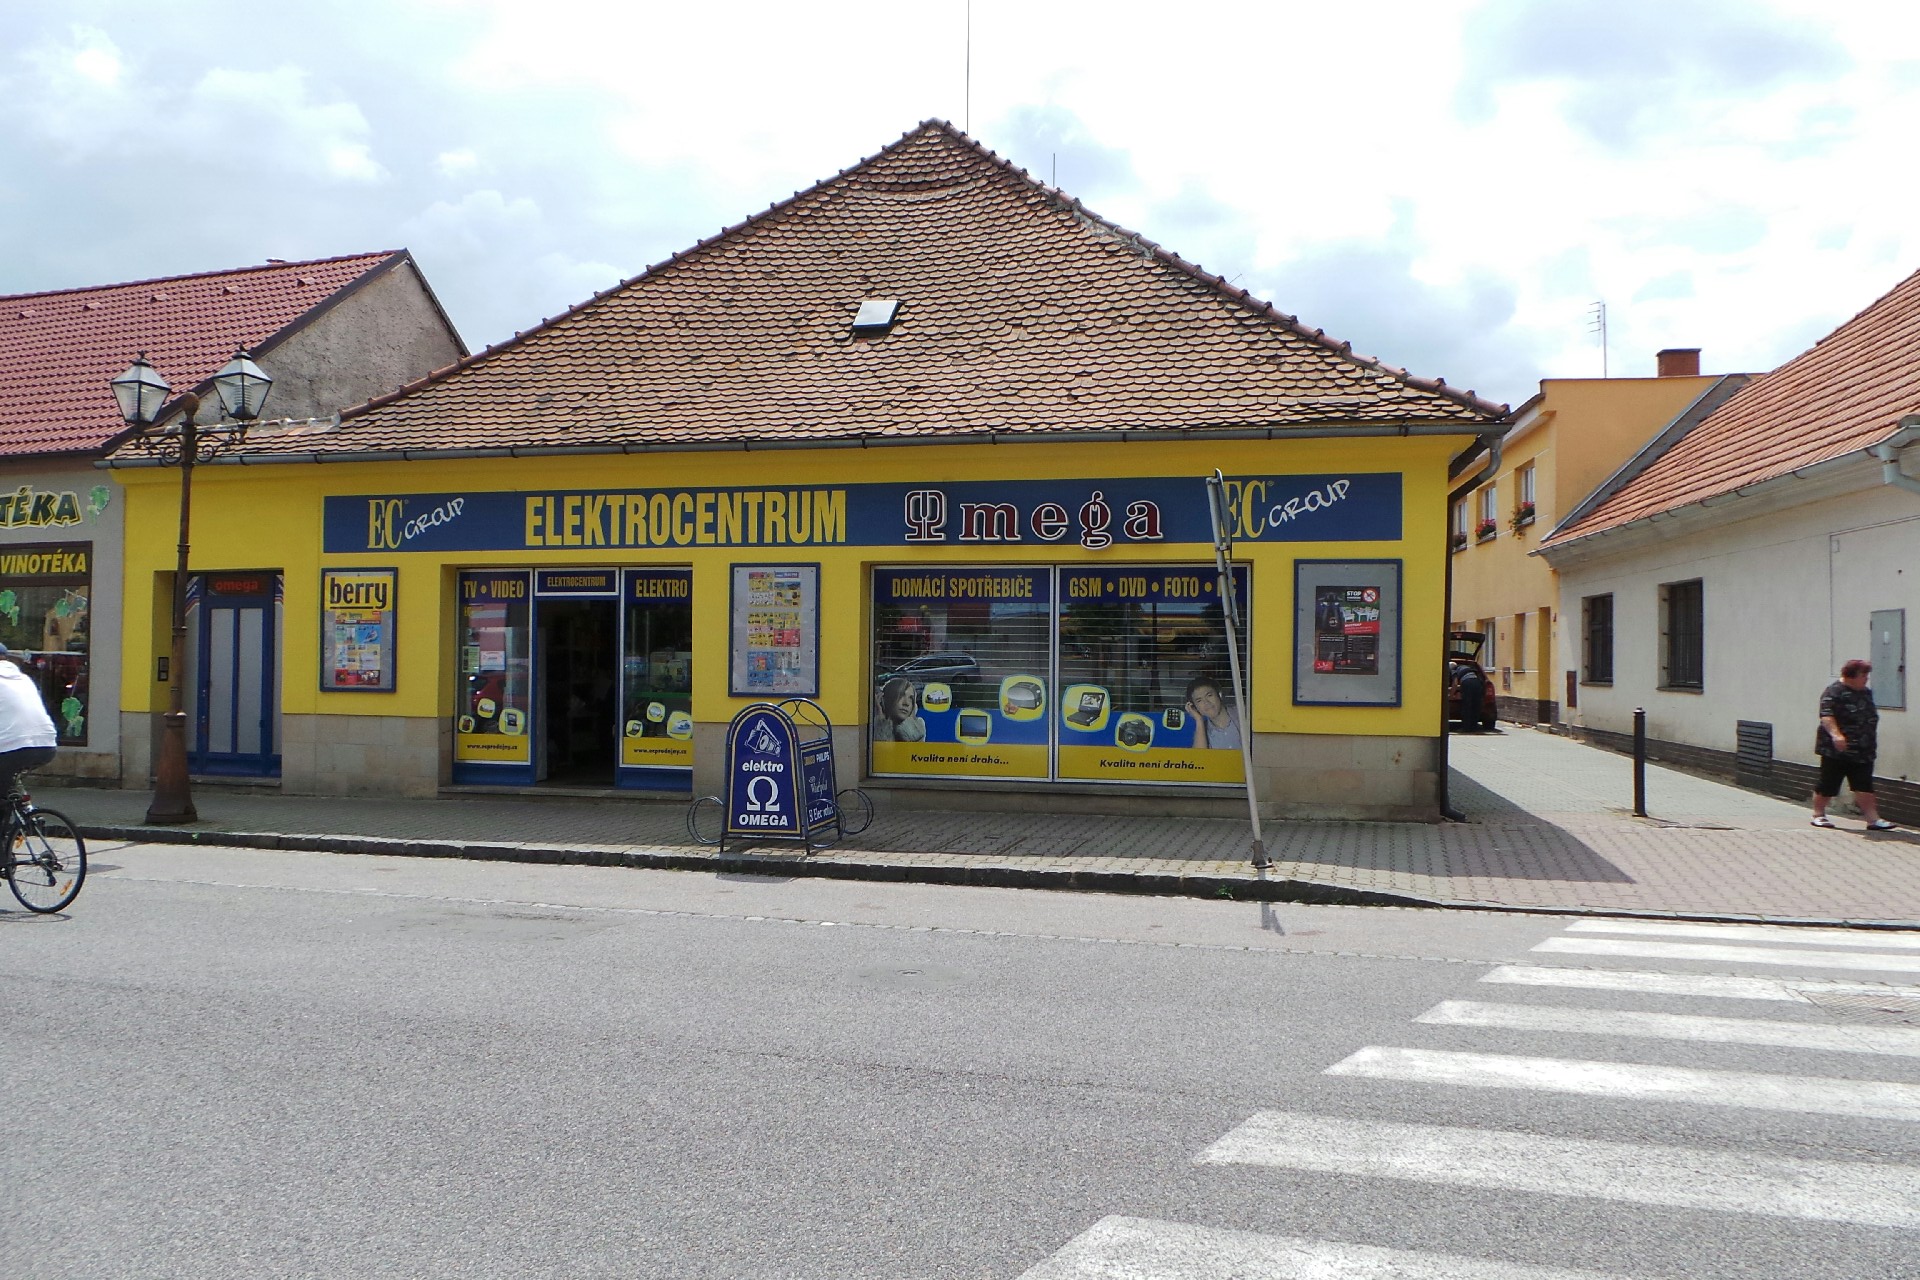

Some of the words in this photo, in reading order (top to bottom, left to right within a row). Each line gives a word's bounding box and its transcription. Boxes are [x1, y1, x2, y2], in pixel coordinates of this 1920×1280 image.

[1269, 479, 1350, 527] GROUP
[367, 500, 403, 549] EC
[404, 498, 464, 540] GROUP
[525, 490, 846, 546] ELEKTROCENTRUM
[0, 549, 87, 574] VINOTÉKA
[464, 581, 477, 598] TV
[490, 581, 524, 598] VIDEO
[547, 576, 606, 588] ELEKTROCENTRUM
[635, 579, 688, 598] ELEKTRO
[892, 575, 945, 598] DOMÁCÍ
[949, 575, 1032, 598] SPOTŘEBIČE
[1069, 576, 1101, 598] GSM
[1119, 577, 1147, 598] DVD
[1164, 577, 1199, 598] FOTO
[330, 577, 387, 609] berry
[1346, 590, 1361, 598] STOP
[742, 760, 784, 773] elektro
[911, 754, 944, 763] Kvalita
[947, 754, 968, 764] není
[971, 754, 1009, 765] drahá...
[1100, 759, 1136, 768] Kvalita
[1139, 759, 1161, 769] není
[1164, 760, 1205, 770] drahá...
[738, 814, 789, 826] OMEGA
